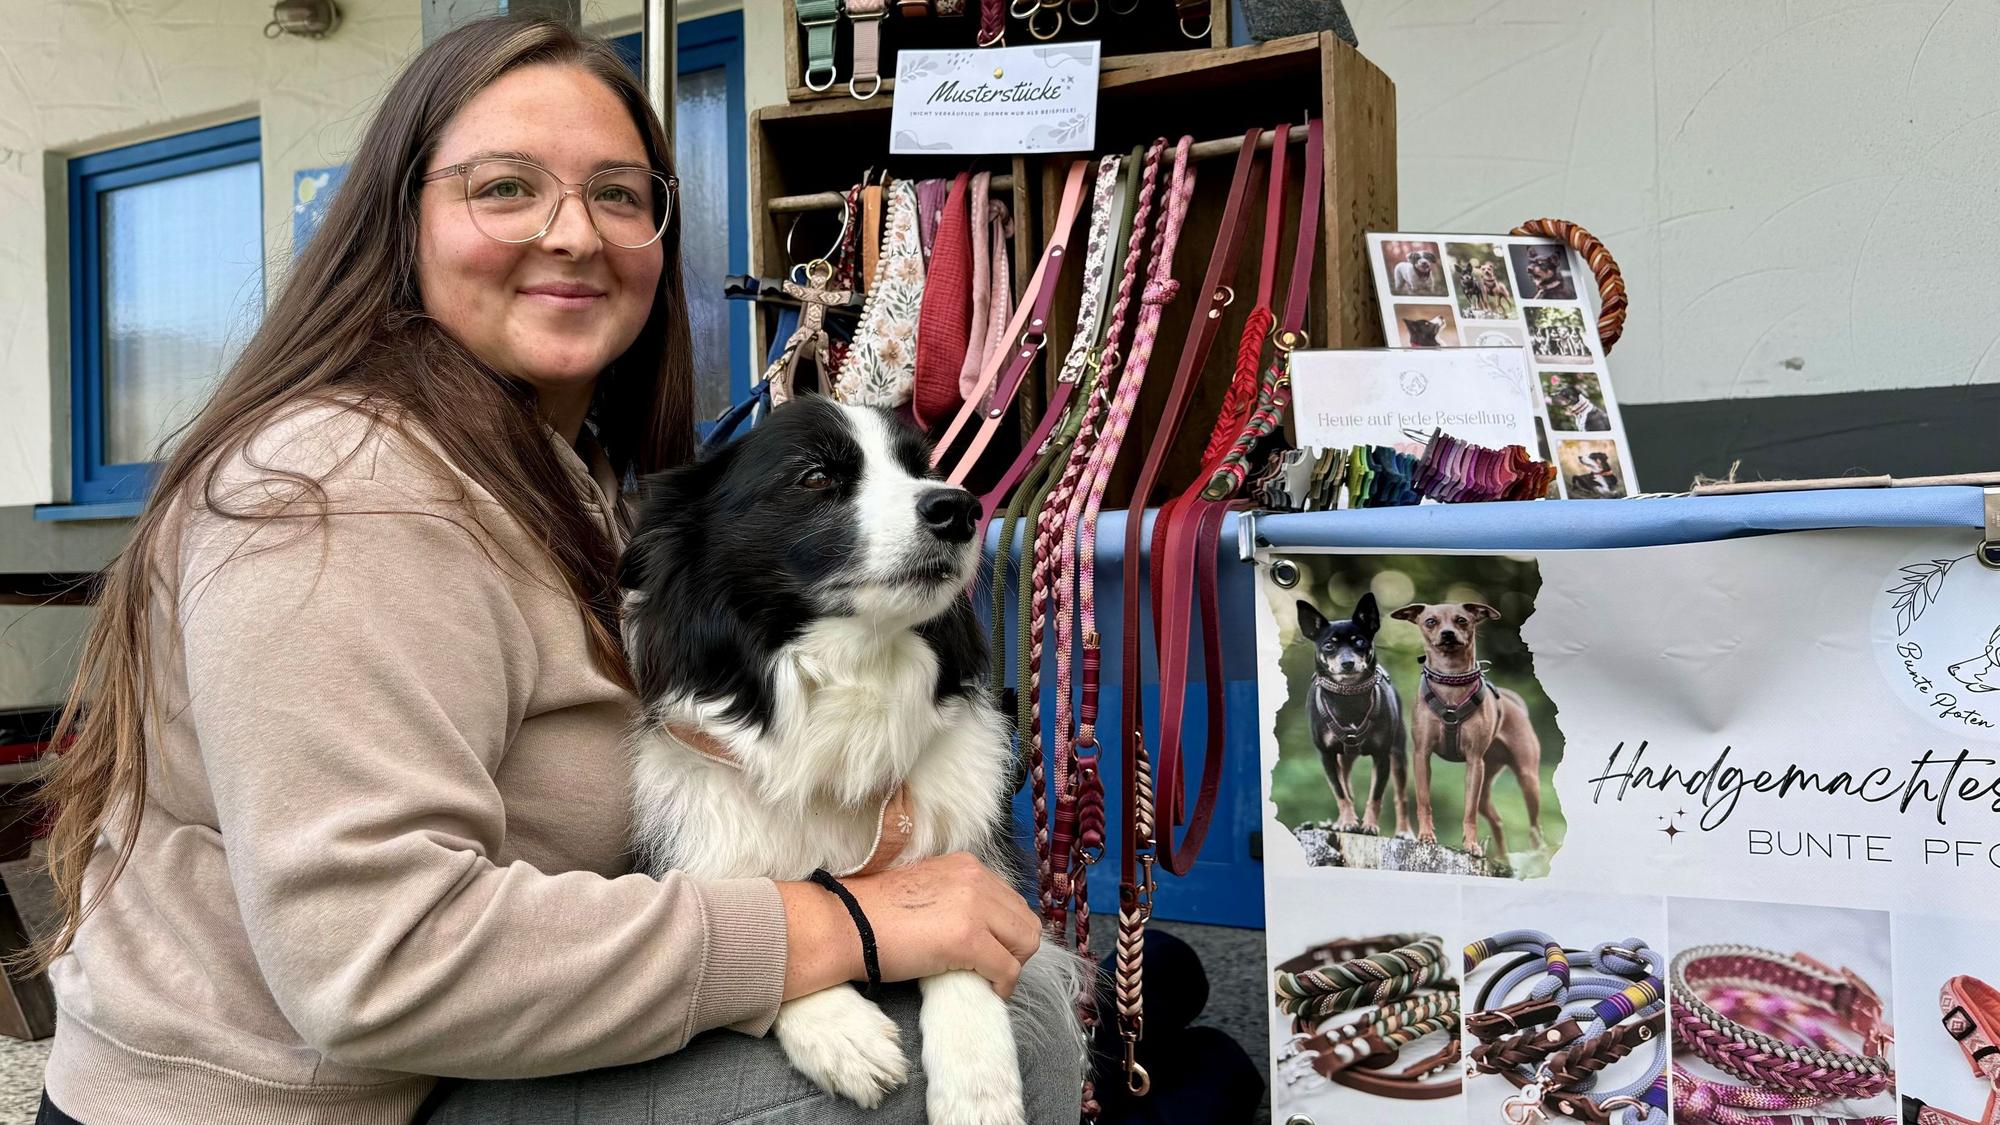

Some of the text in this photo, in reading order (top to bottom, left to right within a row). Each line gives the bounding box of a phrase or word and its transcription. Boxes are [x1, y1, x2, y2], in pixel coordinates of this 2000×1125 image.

[926, 76, 1061, 105] Musterstücke
[1318, 410, 1517, 431] Heute auf jede Bestellung
[1896, 641, 1995, 728] Bunte Pfoten
[1588, 740, 2000, 832] Handgemachtes
[1748, 829, 1893, 862] BUNTE
